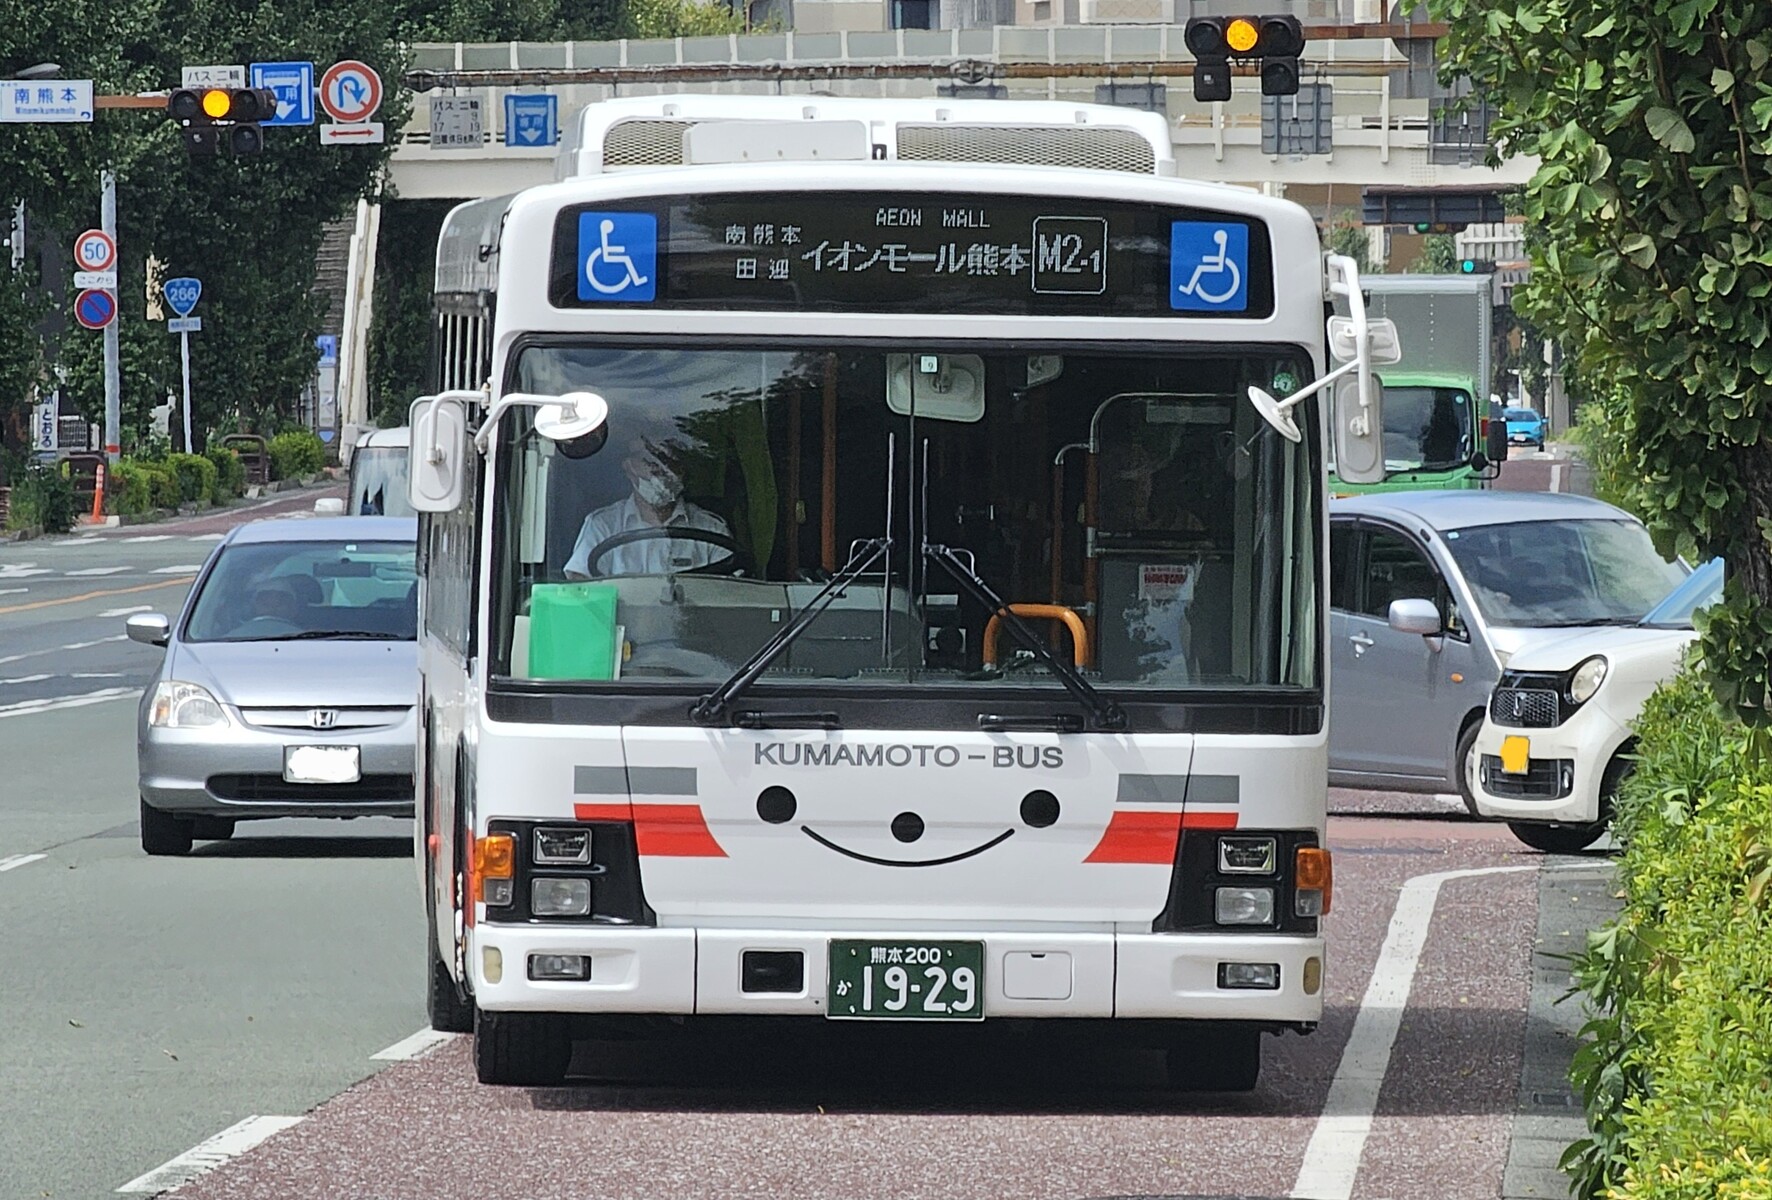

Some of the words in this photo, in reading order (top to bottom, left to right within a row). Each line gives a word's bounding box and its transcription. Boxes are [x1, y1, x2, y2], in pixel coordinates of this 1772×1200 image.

[15, 88, 76, 104] 南熊本
[434, 121, 445, 132] 17
[470, 121, 480, 132] 19
[435, 112, 442, 121] 7
[471, 112, 478, 121] 9
[876, 208, 922, 227] AEON
[942, 208, 991, 228] MALL
[725, 223, 802, 246] 南熊本
[84, 242, 106, 261] 50
[801, 240, 1031, 276] イオンモール熊本
[736, 258, 790, 280] 田迎
[170, 287, 196, 301] 266
[754, 742, 960, 768] KUMAMOTO
[993, 745, 1064, 769] BUS
[836, 979, 852, 997] か
[863, 966, 975, 1012] 19-29
